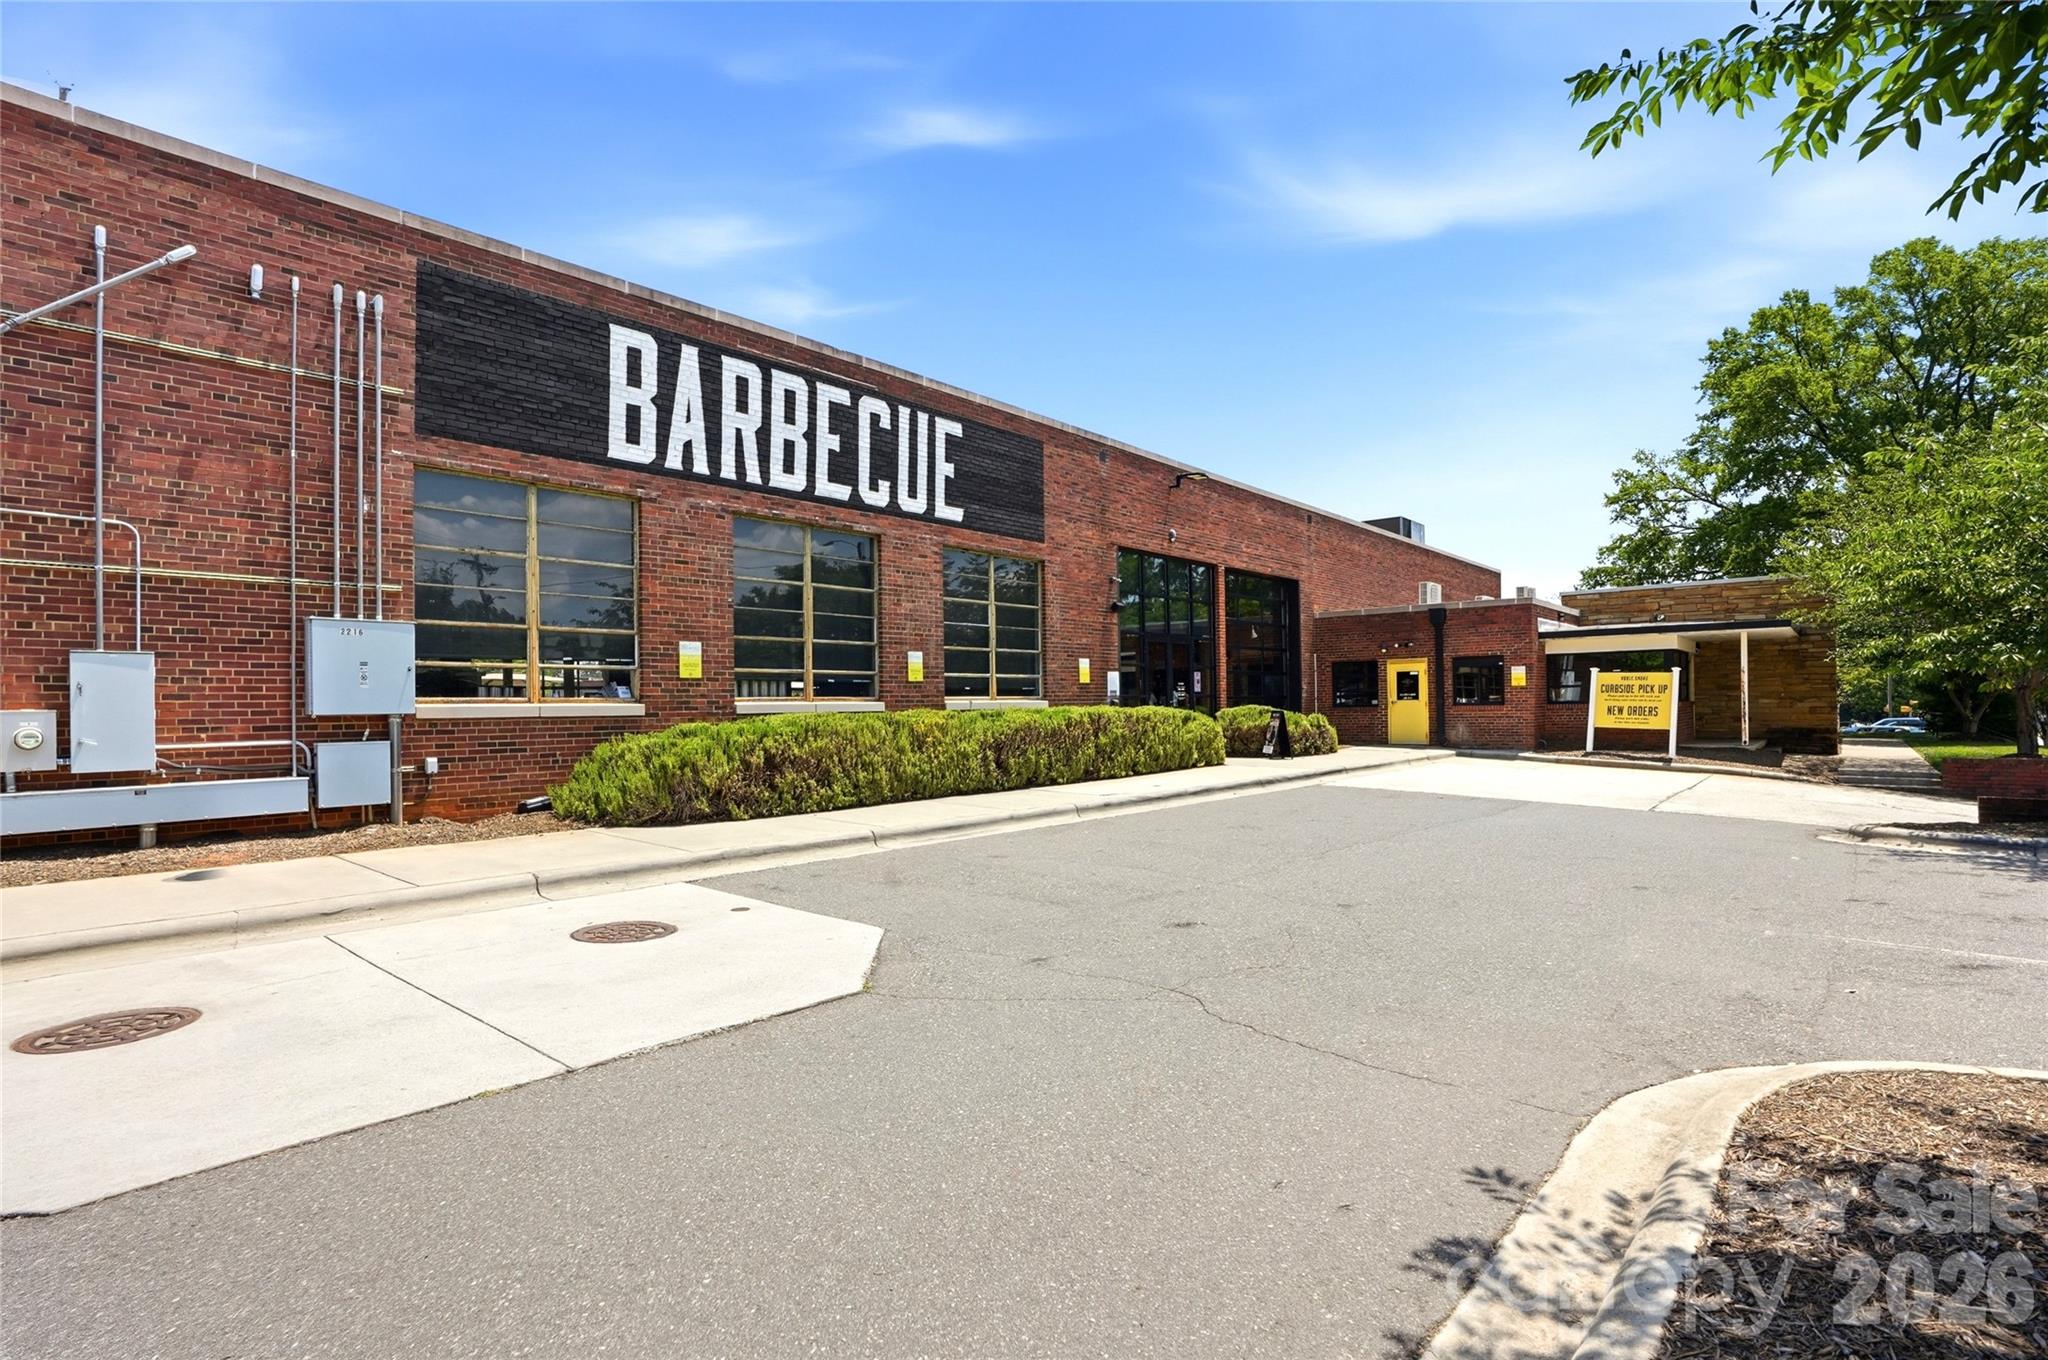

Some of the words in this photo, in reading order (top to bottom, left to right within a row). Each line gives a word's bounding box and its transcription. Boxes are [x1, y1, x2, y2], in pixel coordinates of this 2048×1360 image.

[607, 323, 965, 522] BARBECUE
[341, 628, 363, 636] 2216
[1600, 684, 1635, 693] CURBSIDE
[1638, 684, 1655, 694] PICK
[1658, 684, 1668, 694] UP
[1607, 705, 1625, 716] NEW
[1627, 705, 1659, 717] ORDERS
